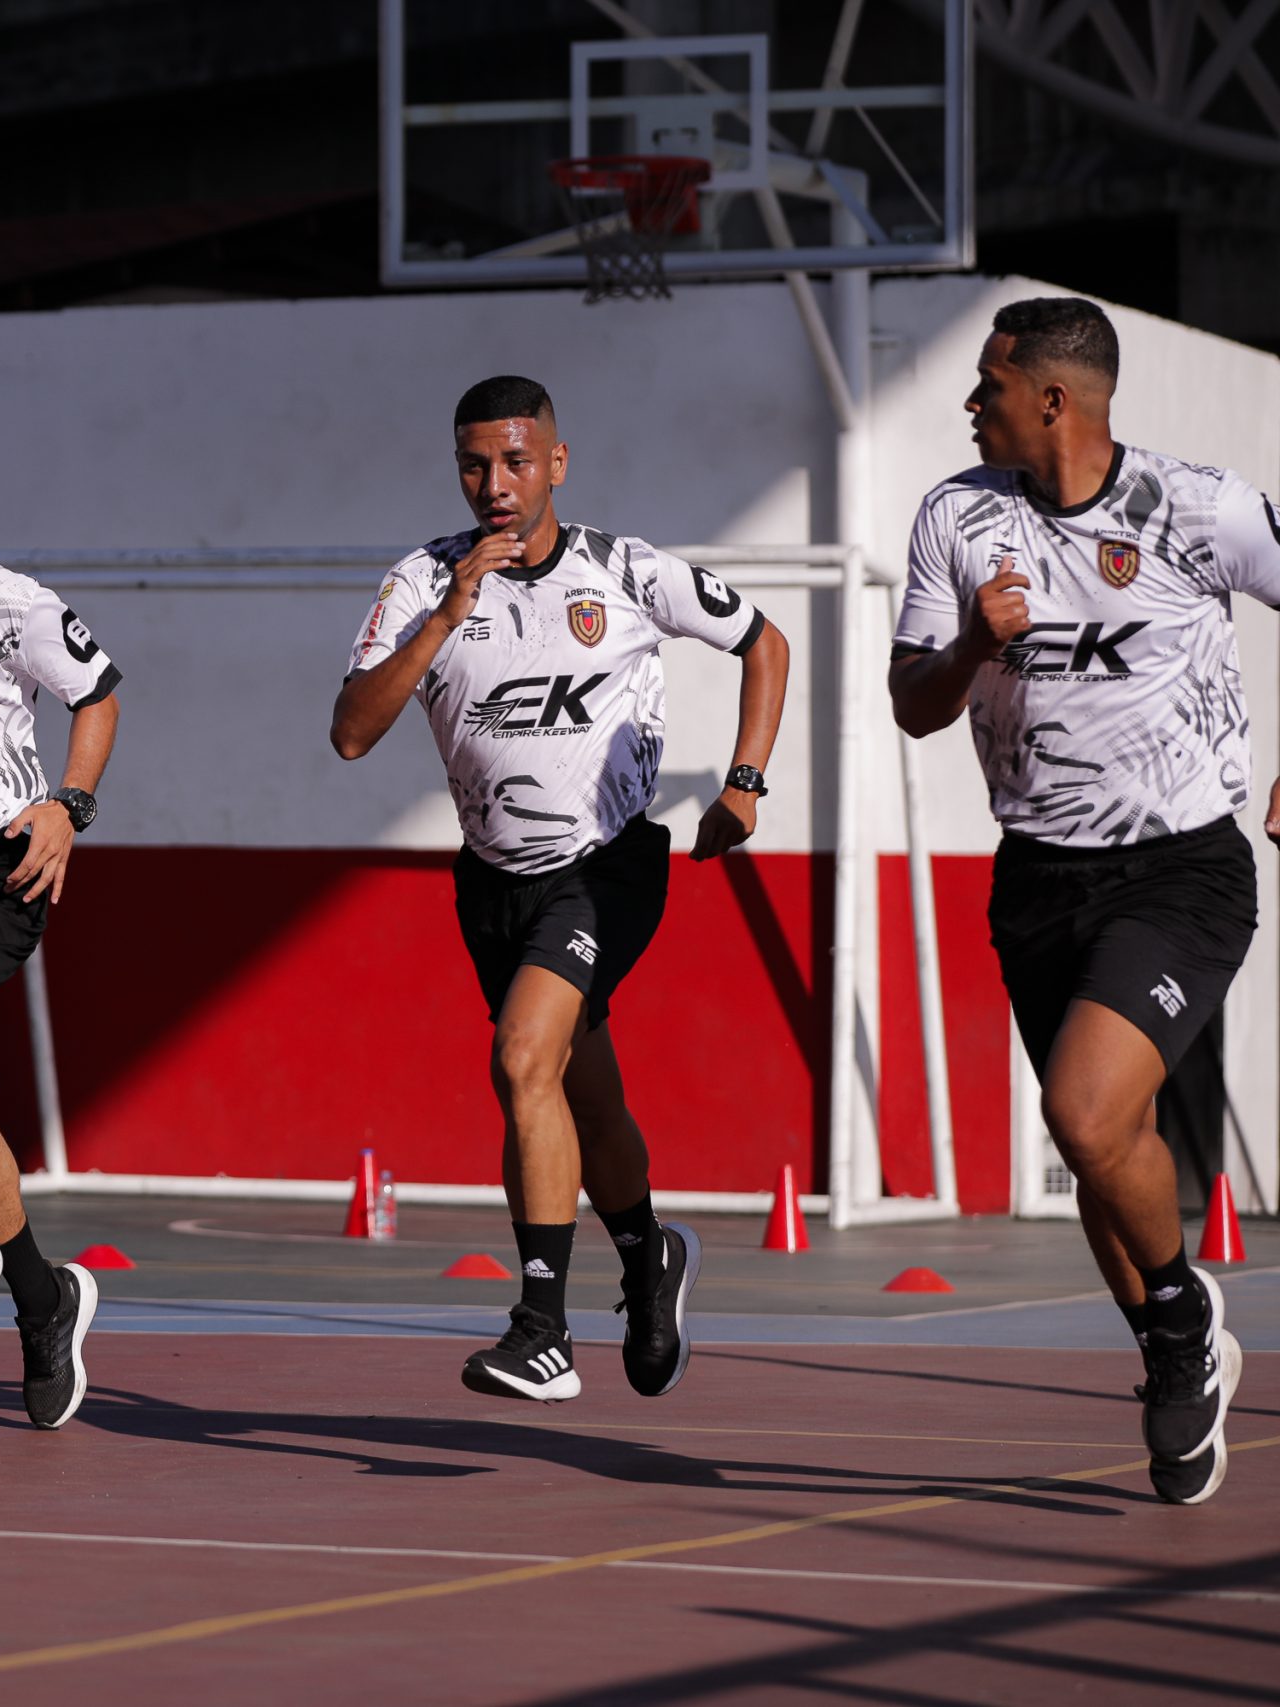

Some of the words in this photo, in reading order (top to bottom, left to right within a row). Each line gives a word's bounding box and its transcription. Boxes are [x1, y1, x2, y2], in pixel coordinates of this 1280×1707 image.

[564, 587, 605, 600] ÁRBITRO
[462, 626, 491, 642] RS
[466, 672, 613, 736] EK
[492, 729, 541, 739] EMPIRE
[543, 725, 593, 737] KEEWAY
[566, 939, 597, 966] RS
[1150, 984, 1181, 1018] RS
